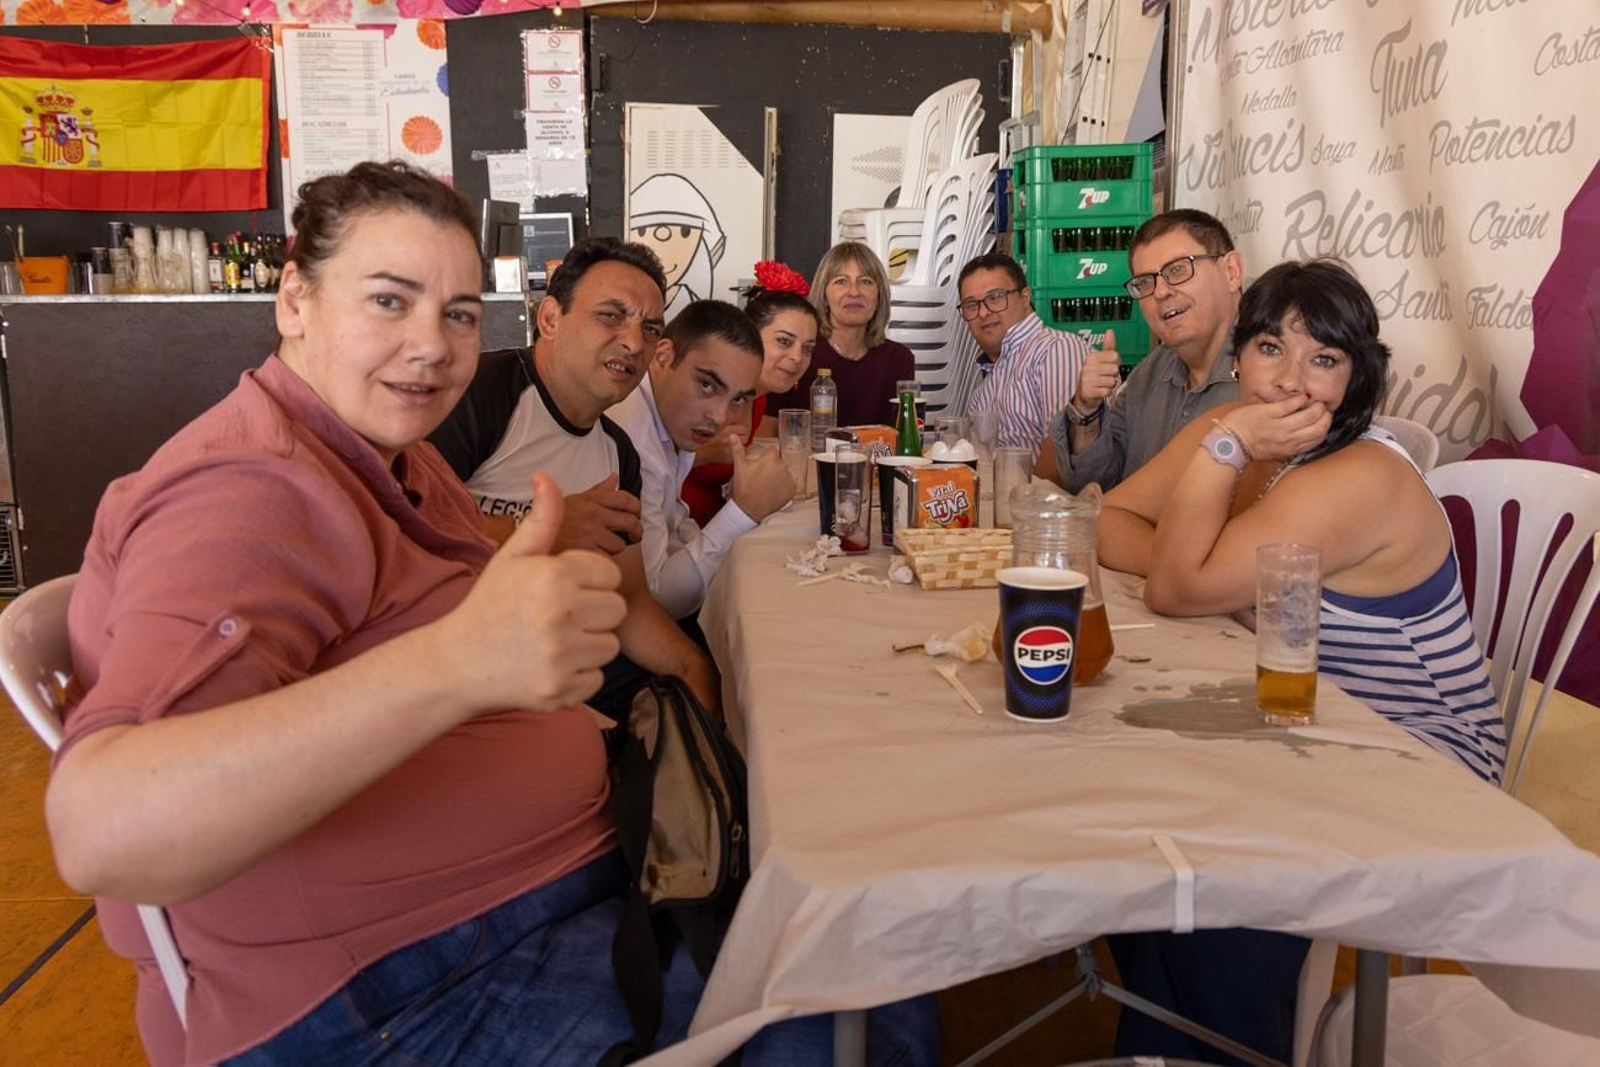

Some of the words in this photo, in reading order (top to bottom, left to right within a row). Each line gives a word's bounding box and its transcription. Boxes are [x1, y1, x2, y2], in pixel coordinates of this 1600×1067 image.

[1369, 16, 1449, 129] Tuna
[1240, 84, 1298, 115] Medalla
[1428, 114, 1576, 175] Potencias
[1077, 187, 1111, 210] 7UP
[1280, 188, 1447, 260] Relicario
[1468, 200, 1550, 250] Cajón
[1076, 257, 1109, 280] 7UP
[479, 496, 533, 516] LEGIÓ
[1017, 647, 1071, 661] PEPSI
